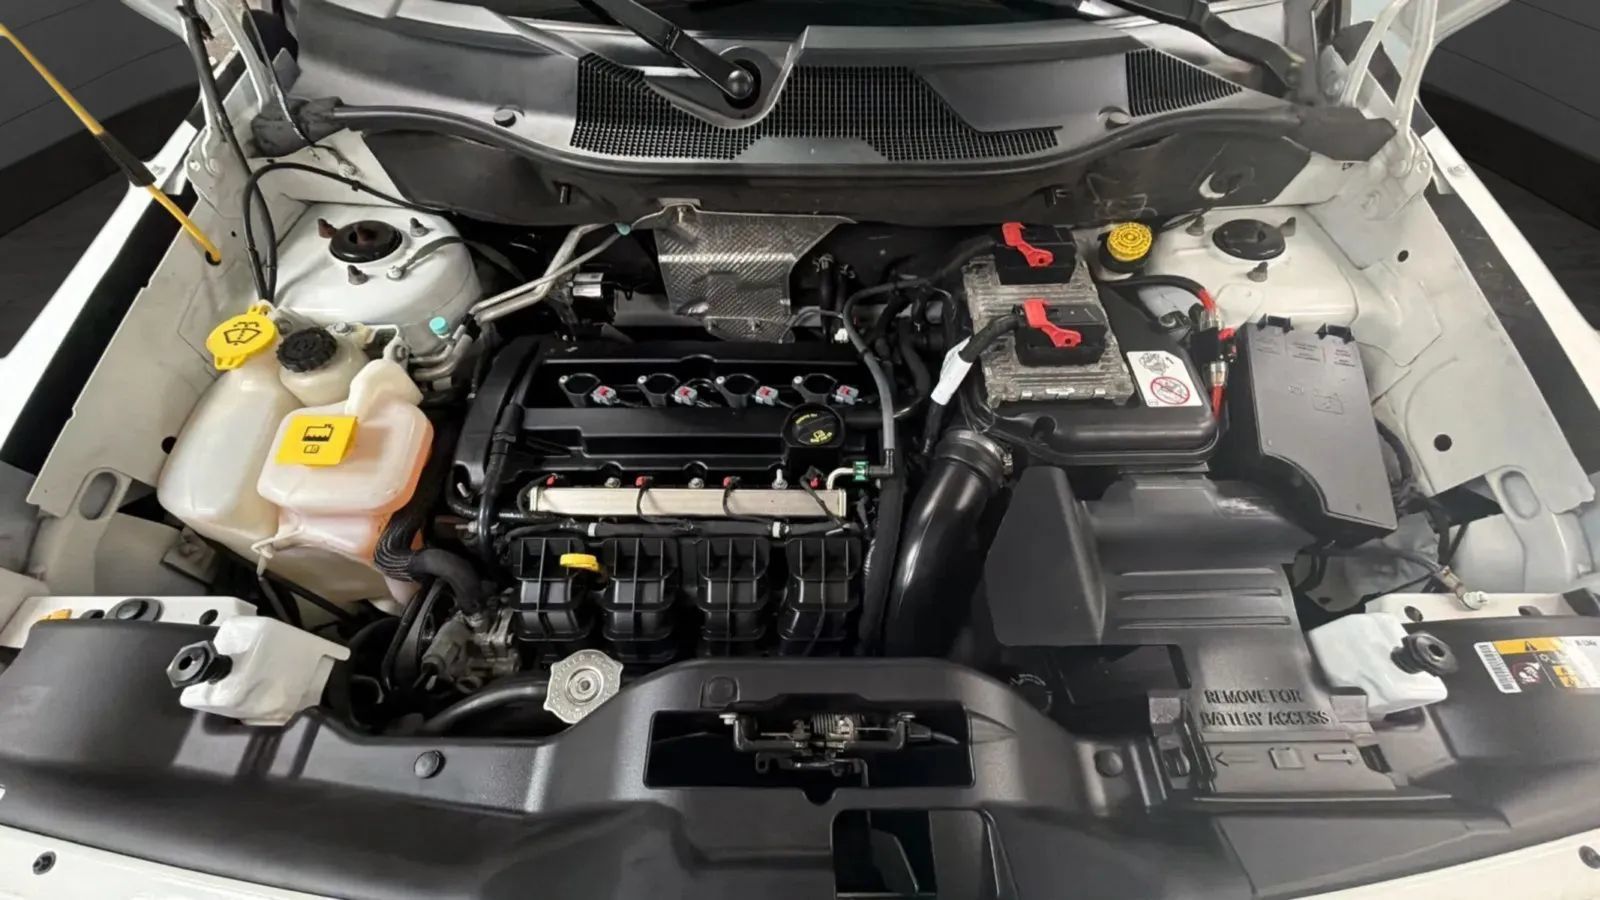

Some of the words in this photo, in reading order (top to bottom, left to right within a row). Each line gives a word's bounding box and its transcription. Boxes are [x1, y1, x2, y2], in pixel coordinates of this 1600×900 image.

[1204, 688, 1267, 704] REMOVE
[1269, 688, 1304, 704] FOR
[1200, 711, 1263, 726] BATTERY
[1267, 710, 1331, 726] ACCESS
